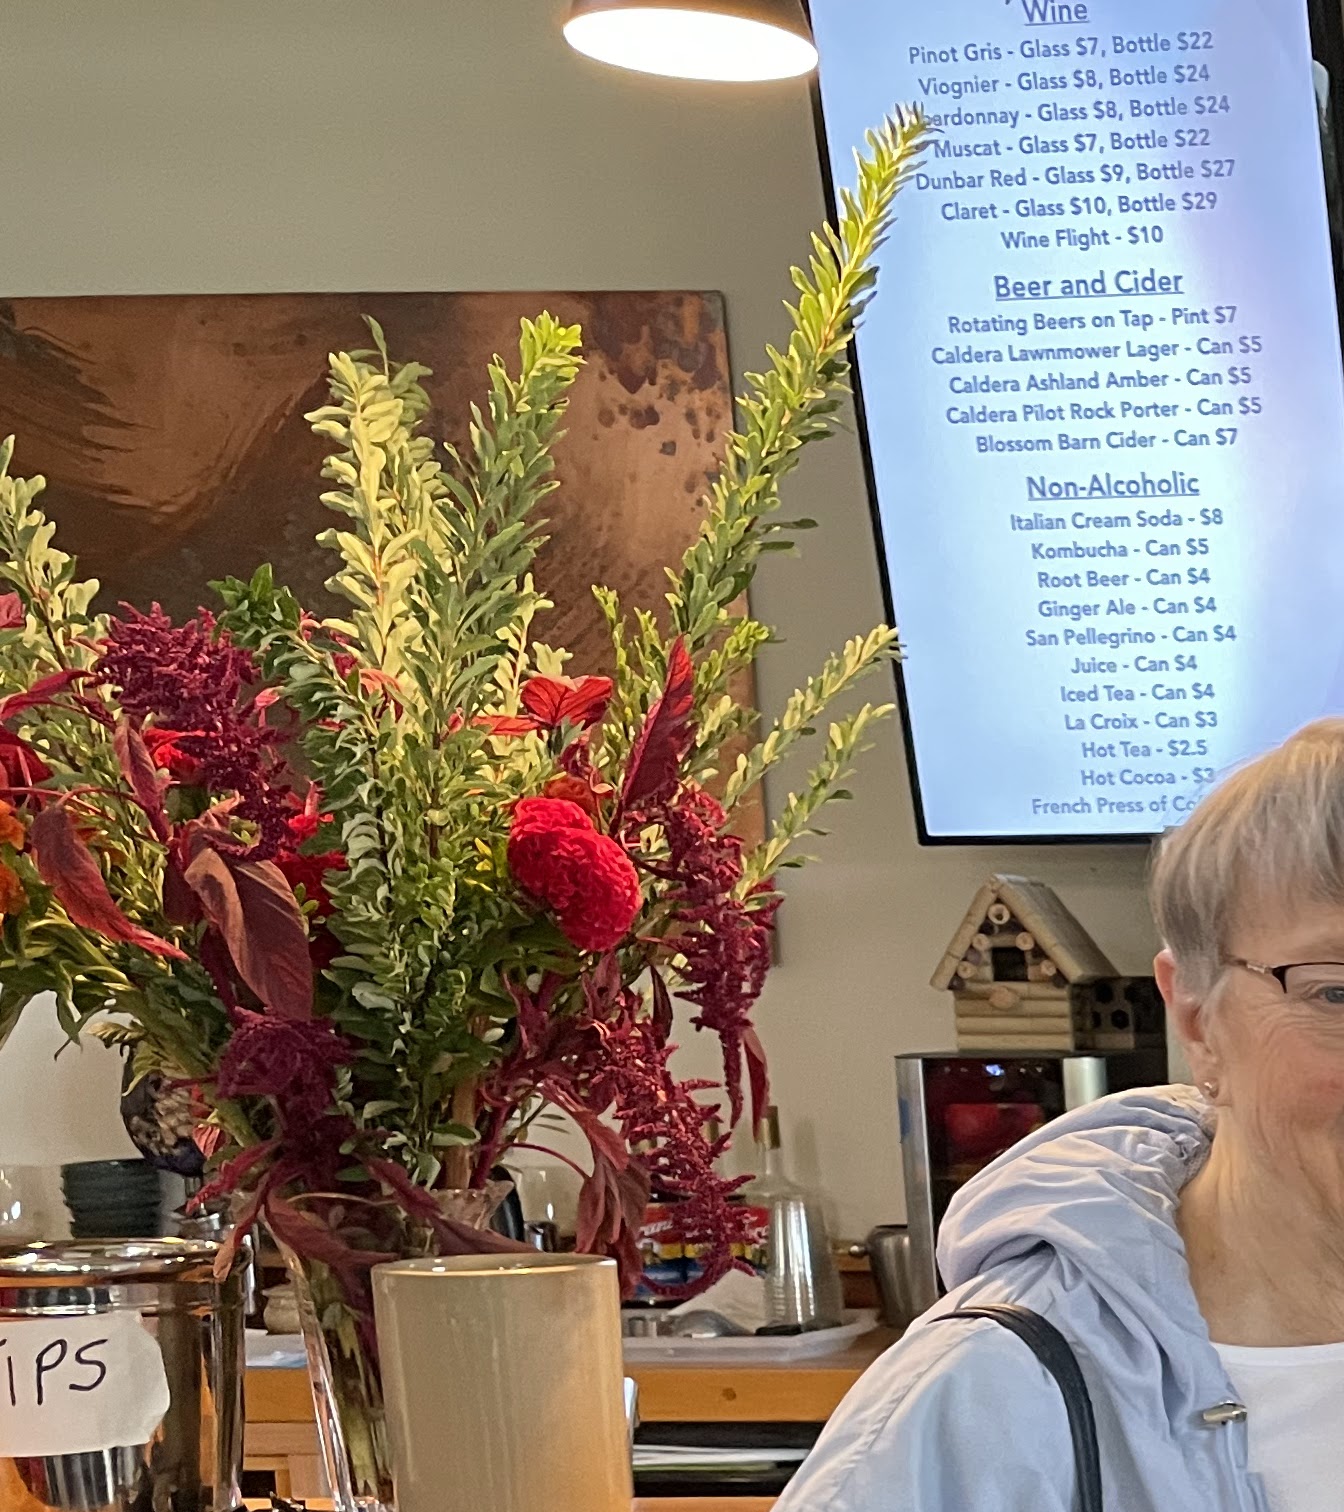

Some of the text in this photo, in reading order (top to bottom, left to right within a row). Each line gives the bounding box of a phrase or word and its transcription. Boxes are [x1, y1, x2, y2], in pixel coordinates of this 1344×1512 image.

[1022, 0, 1088, 22] Wine
[909, 46, 958, 64] Pinot
[964, 42, 1002, 61] Gris
[1020, 38, 1070, 58] Glass
[1076, 36, 1106, 57] $7,
[1112, 32, 1170, 53] Bottle
[1177, 31, 1213, 50] $22
[918, 75, 999, 99] Viognier
[1017, 71, 1067, 91] Glass
[1073, 69, 1102, 89] $8,
[1109, 65, 1167, 86] Bottle
[1174, 64, 1209, 83] $24
[922, 106, 1019, 128] ardonnay
[1037, 102, 1088, 121] Glass
[1093, 100, 1122, 121] $8,
[1129, 96, 1187, 117] Bottle
[1194, 95, 1229, 114] $24
[934, 139, 1001, 158] Muscat
[1019, 134, 1068, 154] Glass
[1074, 133, 1104, 153] $7,
[1110, 129, 1168, 150] Bottle
[1174, 128, 1210, 147] $22
[915, 170, 984, 190] Dunbar
[990, 167, 1026, 187] Red
[1045, 165, 1095, 184] Glass
[1100, 163, 1130, 184] $9,
[1136, 160, 1194, 180] Bottle
[1201, 159, 1234, 177] $27
[941, 202, 998, 220] Claret
[1015, 198, 1064, 217] Glass
[1070, 196, 1111, 216] $10,
[1117, 192, 1175, 213] Bottle
[1182, 191, 1216, 210] $29
[1000, 231, 1049, 249] Wine
[1055, 226, 1110, 251] Flight
[1127, 225, 1163, 244] $10
[994, 268, 1183, 297] Beer and Cider
[948, 314, 1027, 335] Rotating
[1033, 313, 1086, 330] Beers
[1091, 315, 1115, 327] on
[1119, 309, 1153, 331] Tap
[1172, 308, 1210, 325] Pint
[1214, 305, 1236, 323] $7
[932, 345, 1002, 364] Caldera
[1008, 344, 1120, 361] Lawnmower
[1126, 341, 1179, 361] Lager
[1196, 337, 1232, 355] Can
[1239, 335, 1262, 353] $5
[949, 375, 1020, 393] Caldera
[1026, 371, 1099, 391] Ashland
[1106, 369, 1169, 388] Amber
[1186, 368, 1222, 385] Can
[1227, 366, 1251, 385] $5
[946, 405, 1017, 424] Caldera
[1022, 403, 1065, 421] Pilot
[1070, 401, 1116, 419] Rock
[1120, 401, 1178, 417] Porter
[1197, 398, 1232, 415] Can
[1238, 396, 1261, 415] $5
[976, 435, 1052, 452] Blossom
[1058, 433, 1100, 450] Barn
[1106, 430, 1156, 448] Cider
[1174, 429, 1210, 446] Can
[1215, 427, 1237, 445] $7
[1026, 471, 1199, 498] Non-Alcoholic
[1010, 512, 1066, 531] Italian
[1071, 512, 1131, 529] Cream
[1136, 509, 1182, 527] Soda
[1200, 508, 1222, 525] $8
[1031, 540, 1128, 559] Kombucha
[1145, 539, 1180, 556] Can
[1186, 538, 1208, 555] $5
[1037, 572, 1082, 588] Root
[1086, 570, 1129, 587] Beer
[1146, 568, 1181, 585] Can
[1187, 567, 1210, 585] $4
[1038, 600, 1100, 621] Ginger
[1106, 598, 1135, 615] Ale
[1153, 597, 1188, 614] Can
[1194, 596, 1216, 613] $4
[1025, 629, 1058, 646] San
[1064, 627, 1155, 649] Pellegrino
[1172, 626, 1208, 642] Can
[1213, 624, 1236, 642] $4
[1071, 656, 1116, 673] Juice
[1134, 655, 1169, 672] Can
[1174, 654, 1197, 671] $4
[1060, 684, 1098, 702] Iced
[1102, 685, 1134, 701] Tea
[1151, 684, 1186, 700] Can
[1191, 682, 1215, 699] $4
[1065, 714, 1085, 730] La
[1090, 712, 1138, 729] Croix
[1155, 712, 1189, 728] Can
[1194, 710, 1217, 728] $3
[1081, 742, 1116, 758] Hot
[1119, 741, 1150, 757] Tea
[1167, 739, 1207, 757] $2.5
[1080, 769, 1115, 785] Hot
[1119, 769, 1176, 785] Cocoa
[1032, 796, 1092, 814] French
[1096, 797, 1144, 813] Press
[1148, 795, 1167, 812] of
[0, 1337, 108, 1406] IPS
